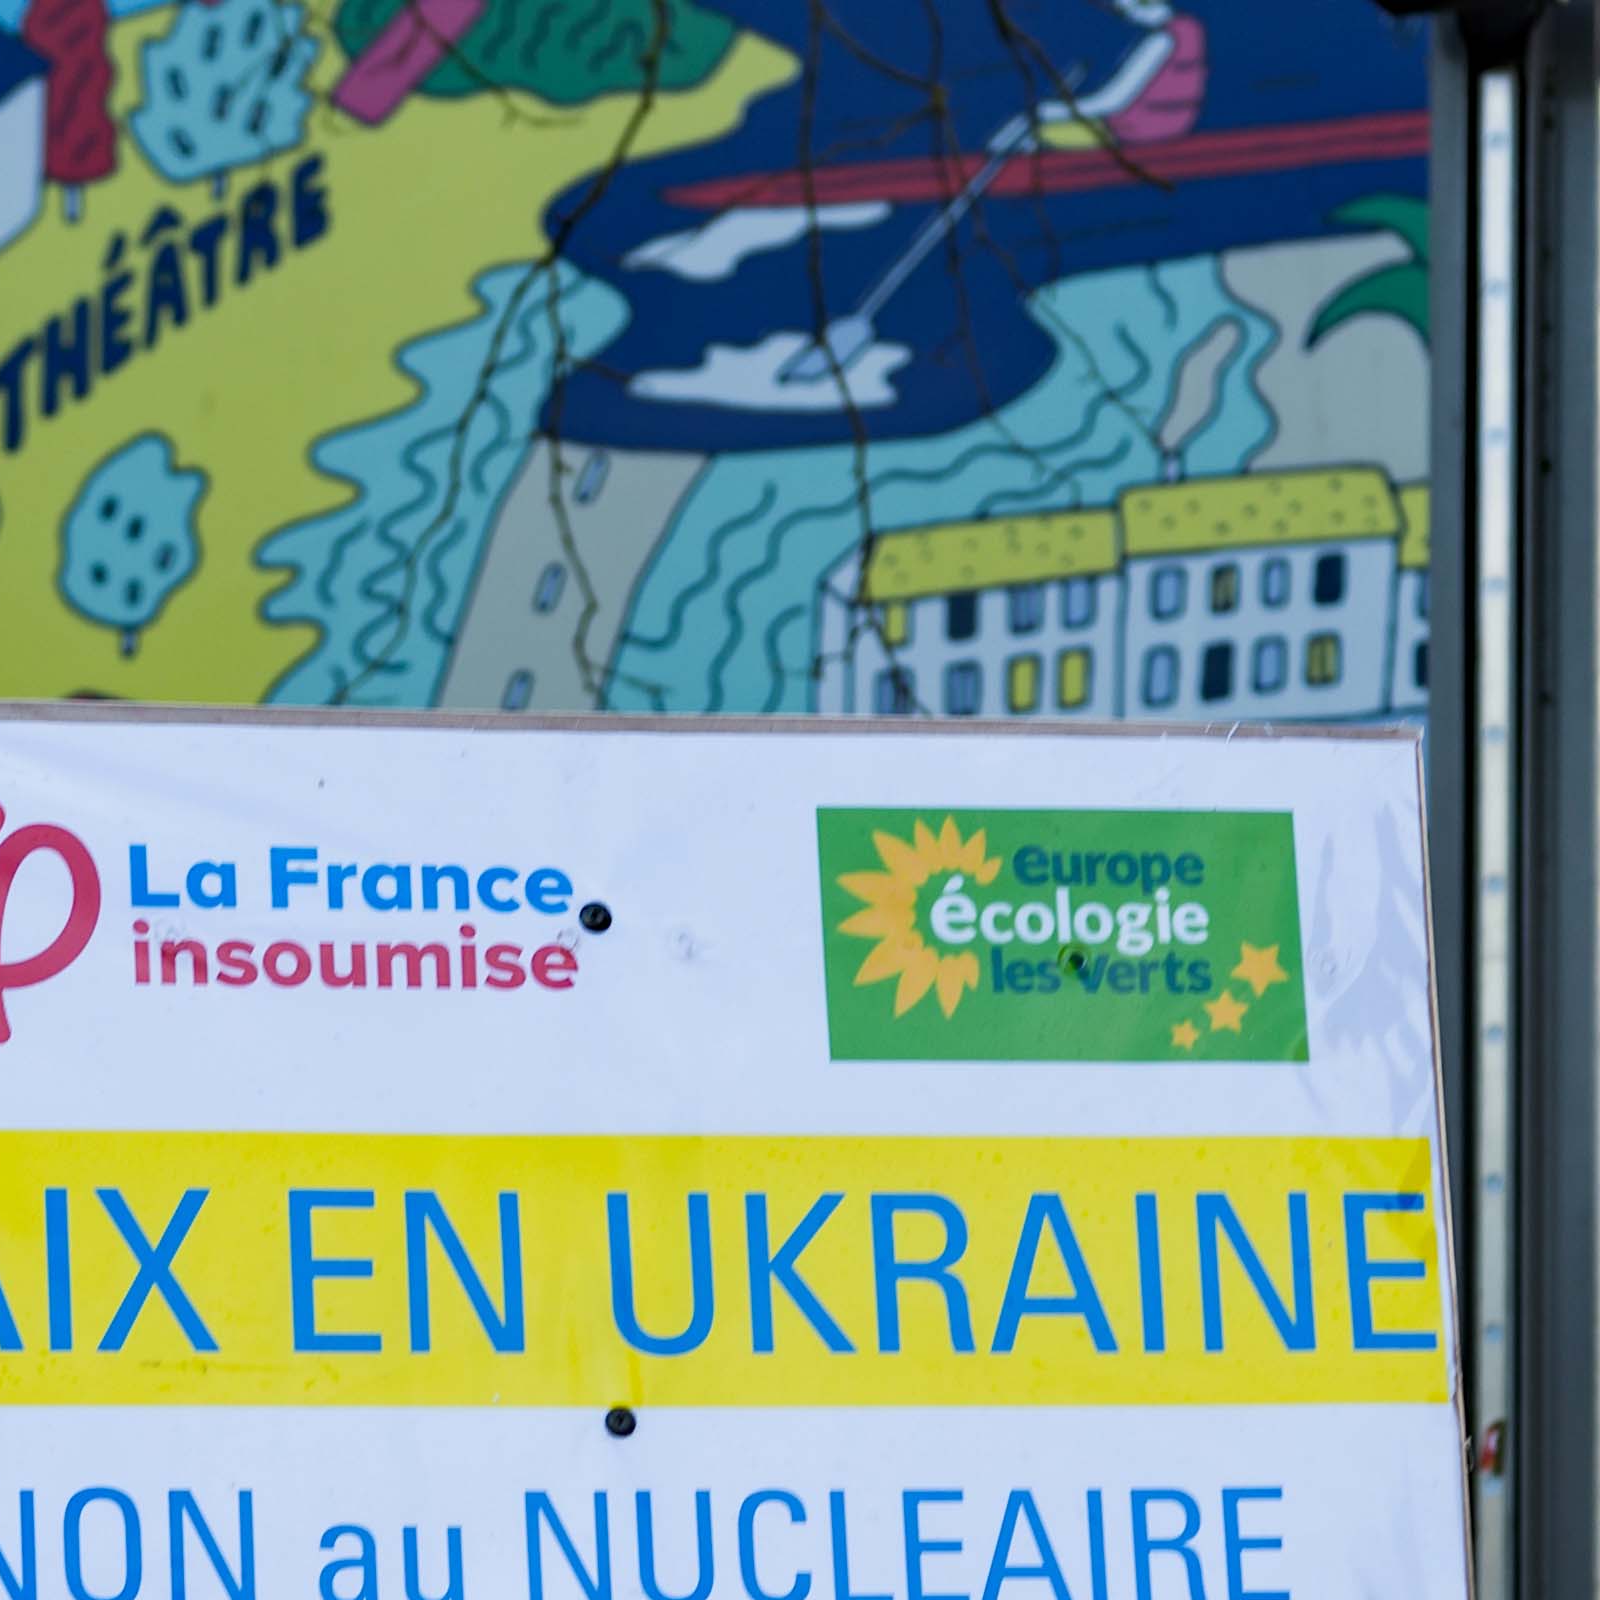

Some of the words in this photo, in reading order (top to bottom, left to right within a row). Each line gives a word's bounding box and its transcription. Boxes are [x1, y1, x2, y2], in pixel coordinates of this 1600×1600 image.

[127, 843, 238, 910] La
[268, 845, 575, 916] France
[1012, 845, 1206, 894] europe
[929, 874, 1210, 956] écologie
[132, 918, 581, 990] insoumise
[990, 946, 1061, 994] les
[288, 1189, 526, 1353] EN
[607, 1192, 1438, 1356] UKRAINE
